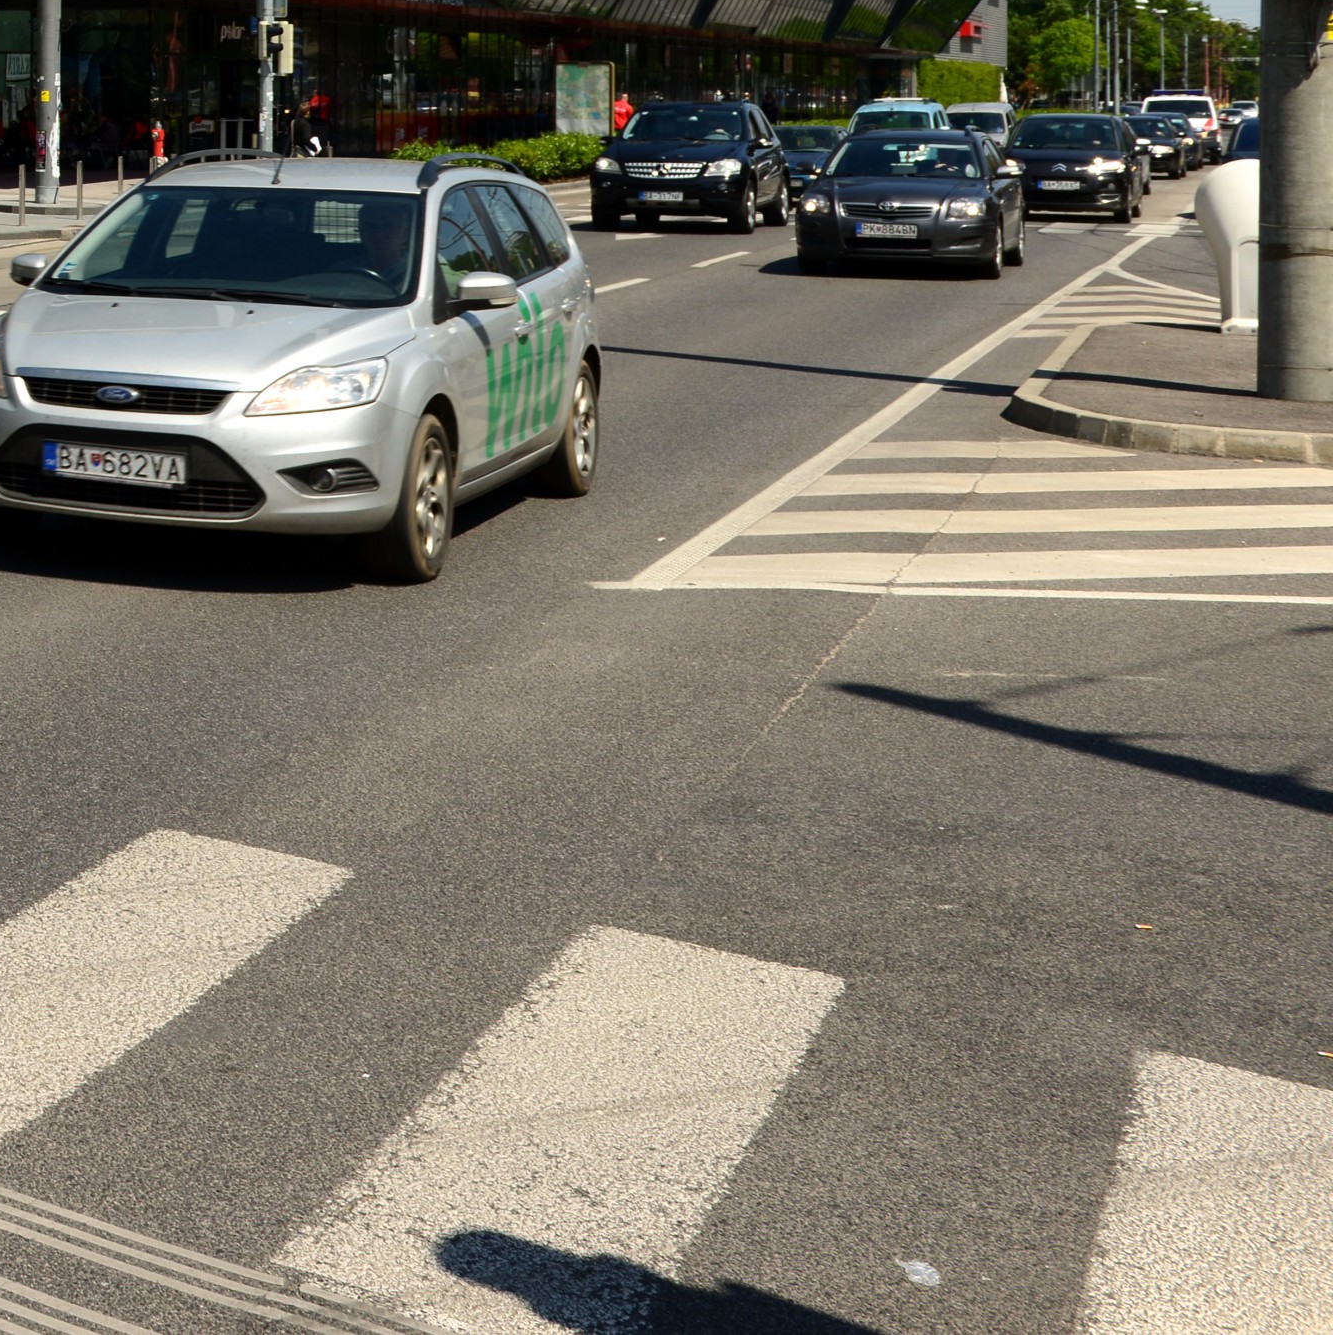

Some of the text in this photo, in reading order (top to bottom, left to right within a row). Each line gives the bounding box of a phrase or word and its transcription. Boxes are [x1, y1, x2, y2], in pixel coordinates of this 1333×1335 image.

[486, 292, 565, 458] wilo
[59, 446, 180, 481] BA 682VA
